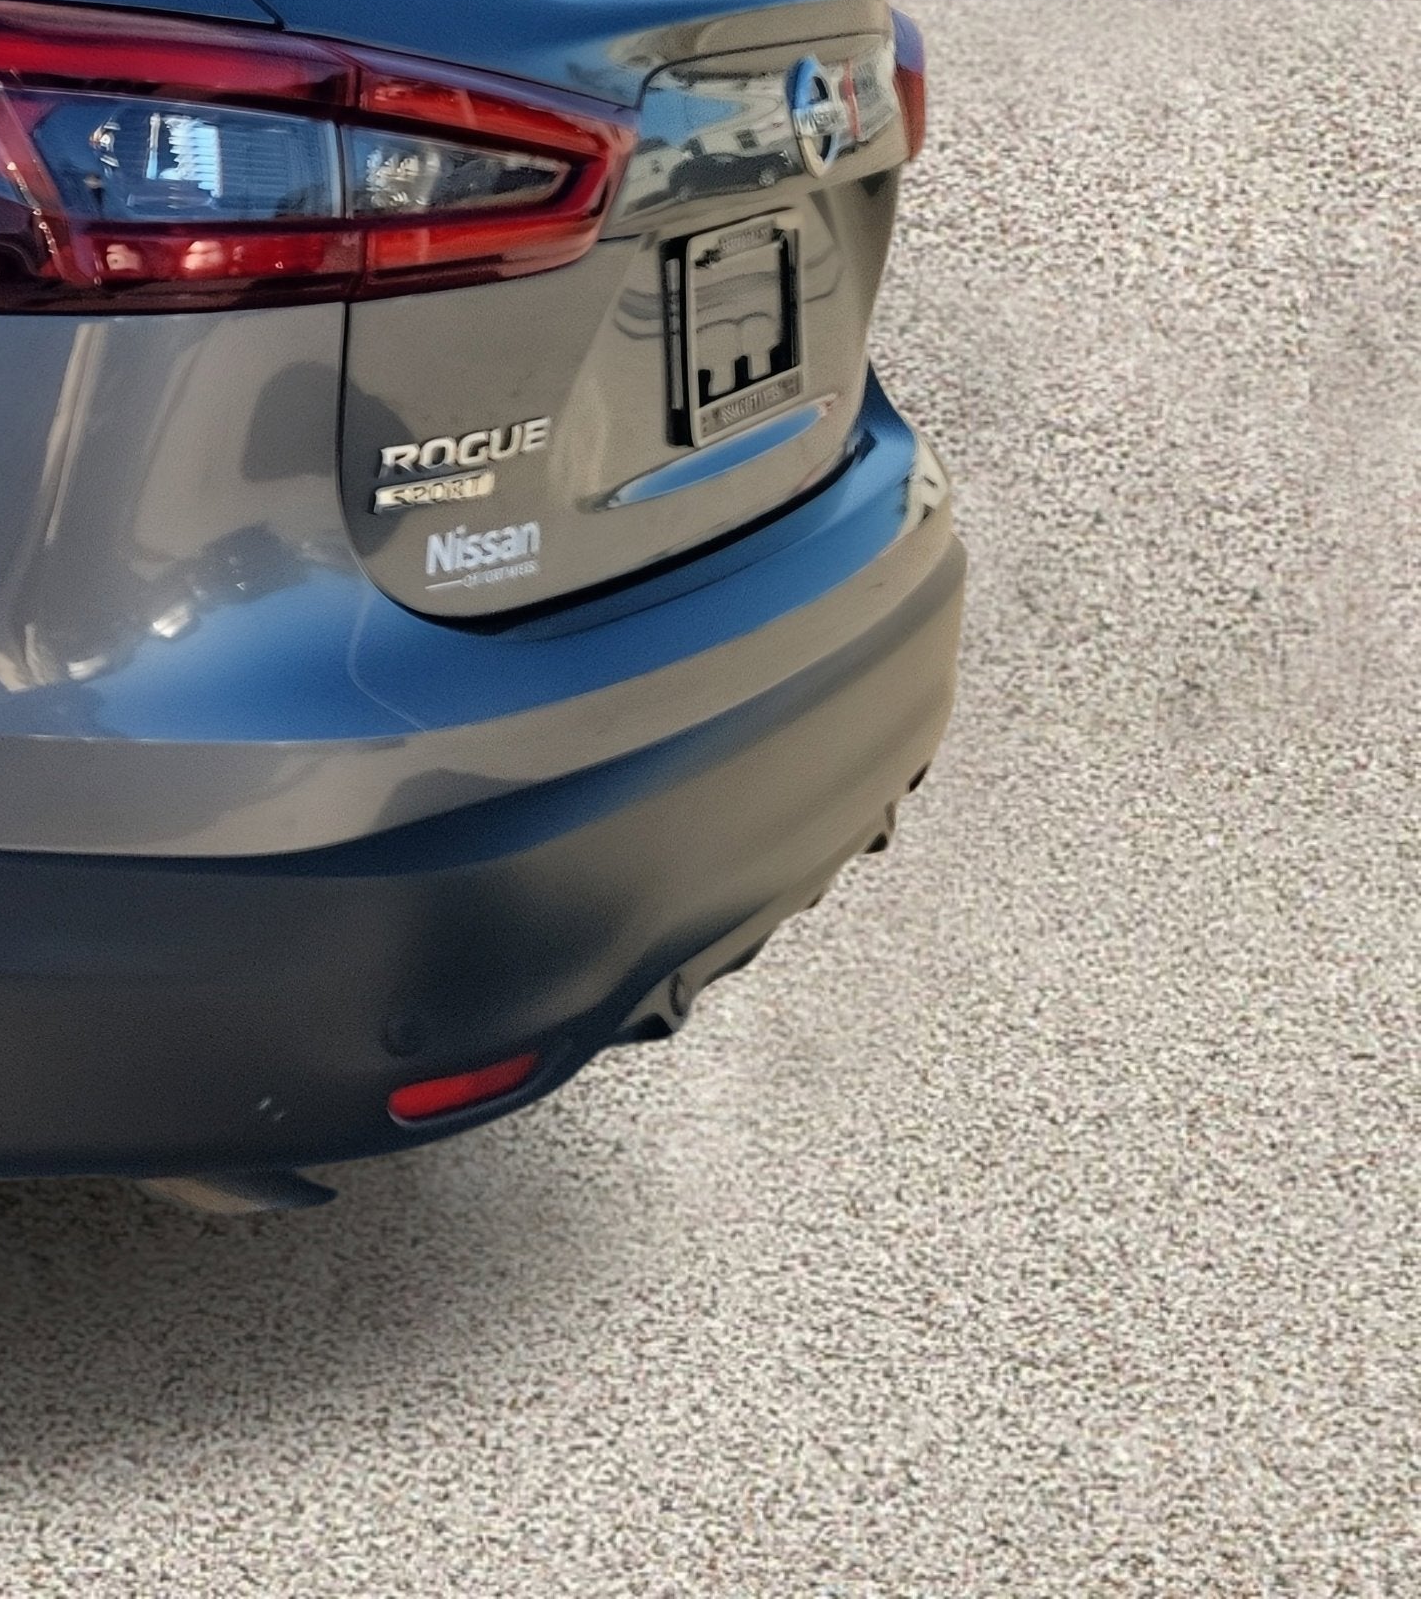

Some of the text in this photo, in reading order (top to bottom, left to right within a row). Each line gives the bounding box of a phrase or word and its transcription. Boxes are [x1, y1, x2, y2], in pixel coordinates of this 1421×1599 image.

[379, 416, 551, 474] ROGUE
[387, 472, 486, 508] SPORT
[425, 521, 541, 576] Nissan
